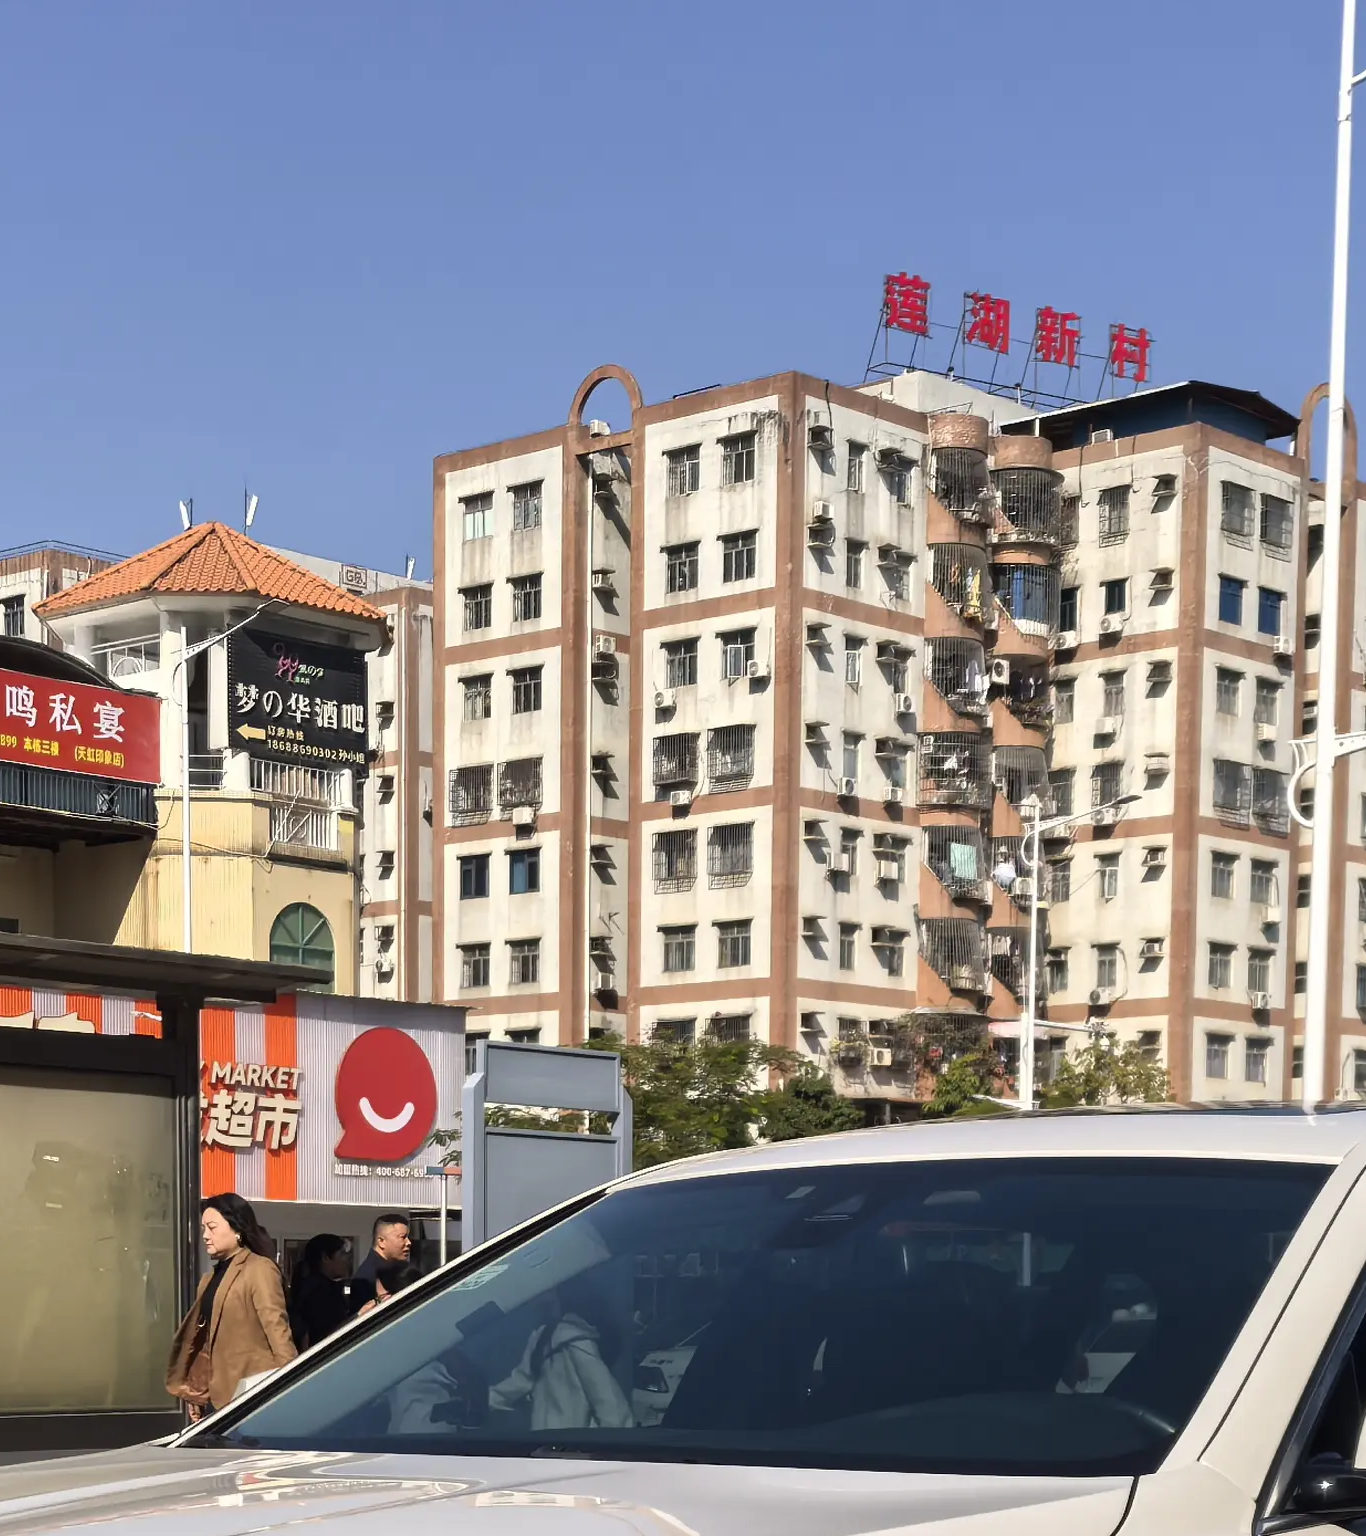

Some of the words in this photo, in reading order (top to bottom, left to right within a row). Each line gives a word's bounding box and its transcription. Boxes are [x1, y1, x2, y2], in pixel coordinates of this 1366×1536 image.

[235, 682, 365, 734] 梦の华酒吧
[211, 1061, 303, 1090] MARKET
[200, 1089, 302, 1150] 超市
